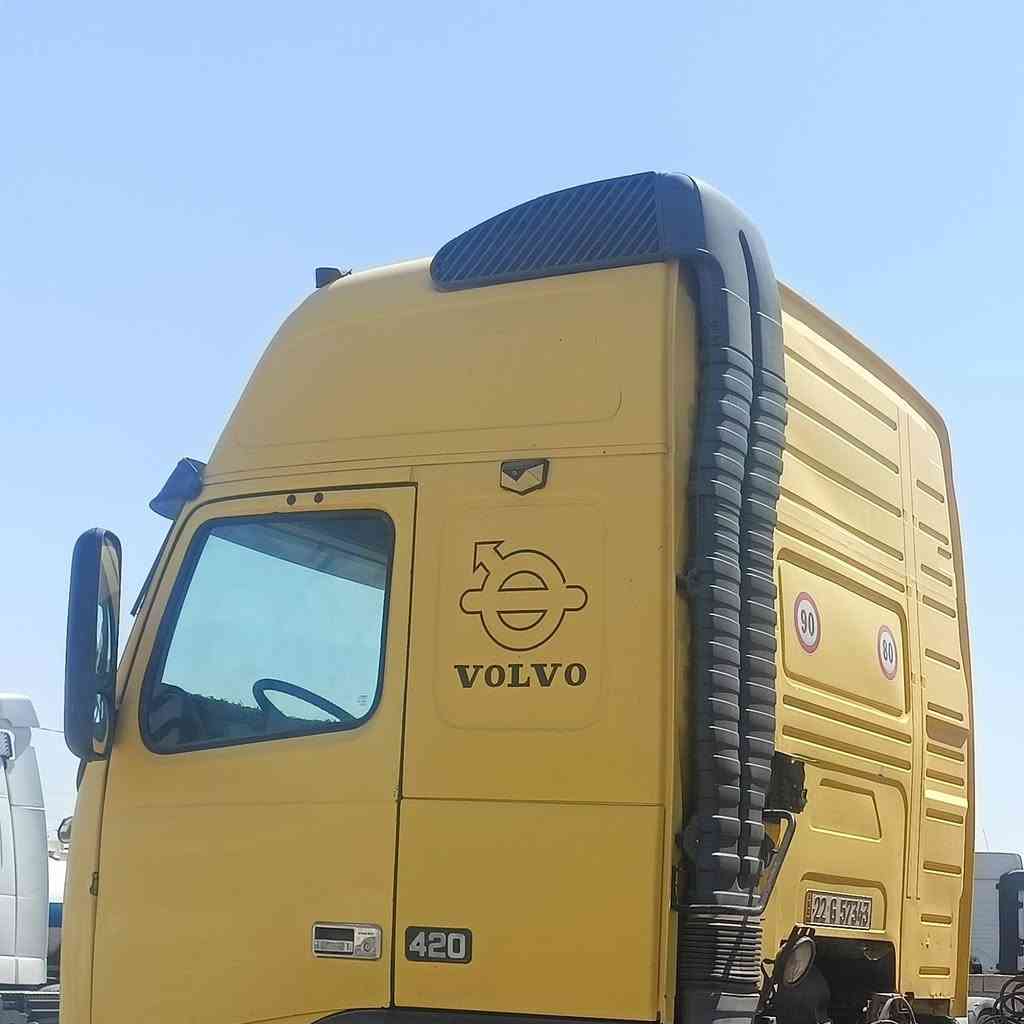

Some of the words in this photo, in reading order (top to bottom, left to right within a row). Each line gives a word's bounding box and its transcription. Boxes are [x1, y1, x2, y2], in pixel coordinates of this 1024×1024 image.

[800, 608, 815, 637] 90
[882, 638, 894, 663] 80
[454, 662, 587, 689] VOLVO
[813, 896, 827, 923] 22
[829, 898, 837, 924] G
[408, 931, 466, 959] 420
